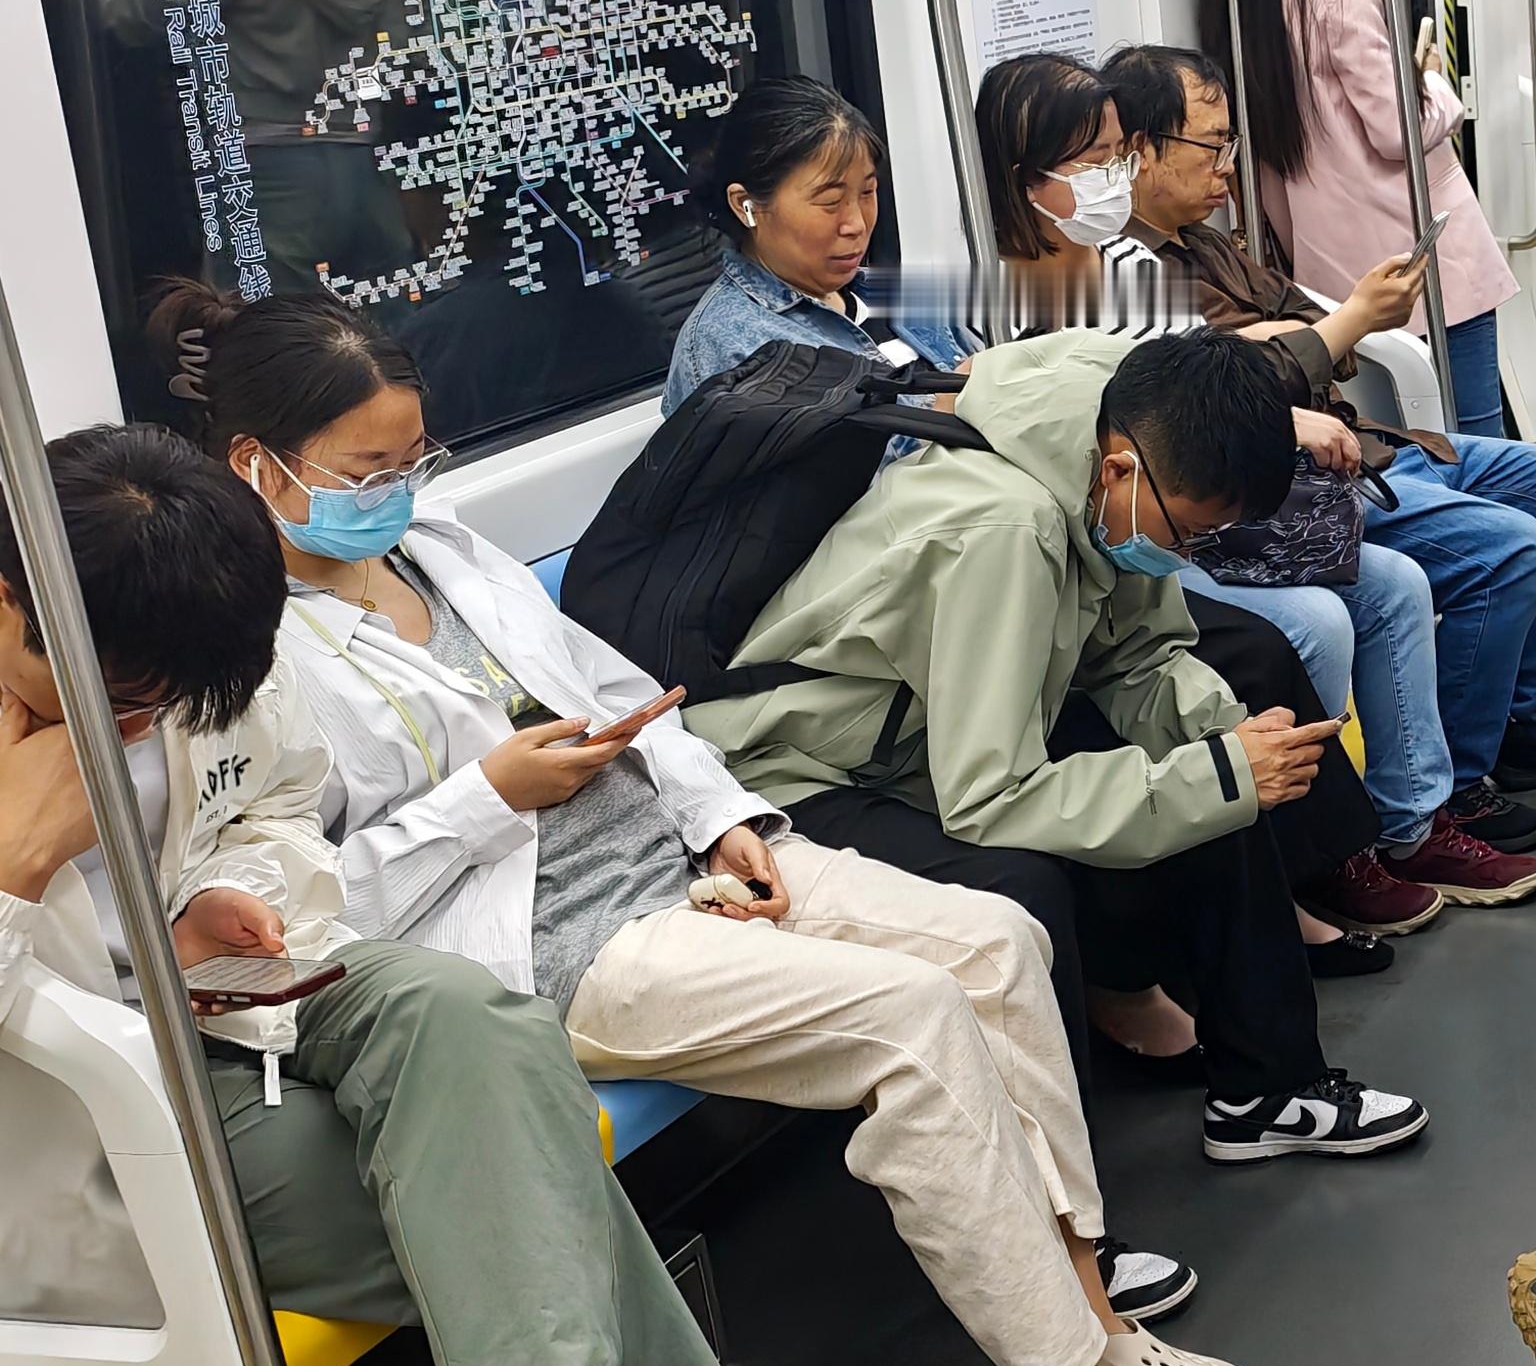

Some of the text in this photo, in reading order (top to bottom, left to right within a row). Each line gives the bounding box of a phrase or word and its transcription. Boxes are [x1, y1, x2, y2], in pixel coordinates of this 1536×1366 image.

[164, 7, 193, 65] Rail
[177, 69, 212, 171] Transit
[195, 175, 223, 252] Lines
